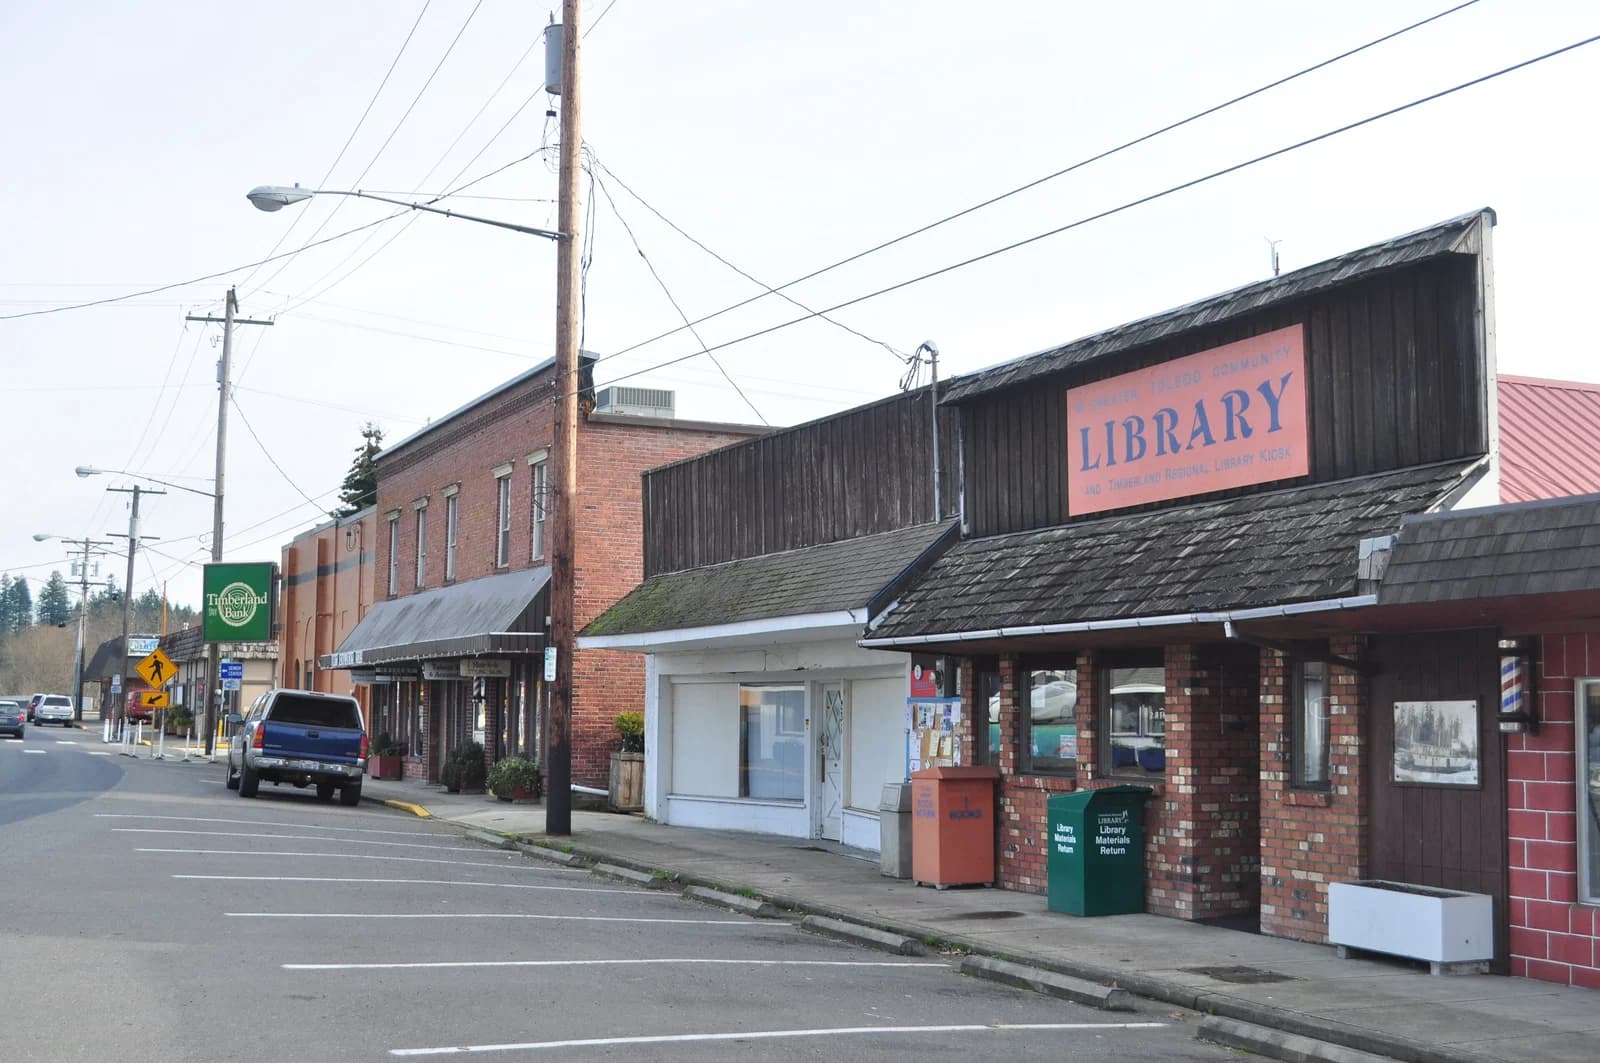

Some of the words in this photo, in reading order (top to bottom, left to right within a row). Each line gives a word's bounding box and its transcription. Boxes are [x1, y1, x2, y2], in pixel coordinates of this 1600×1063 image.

[1151, 369, 1202, 394] TOLEDO
[1212, 345, 1292, 378] COMMUNITY
[1079, 370, 1294, 472] LIBRARY
[1214, 454, 1255, 472] LIBRARY
[1260, 447, 1291, 463] KIOSK
[206, 592, 267, 606] Timberland
[225, 606, 249, 618] Bank
[1056, 823, 1074, 834] Library
[1100, 825, 1126, 836] Library
[1054, 833, 1077, 844] Materials
[1095, 836, 1130, 845] Materials
[1057, 844, 1074, 854] Return
[1100, 846, 1126, 855] Return
